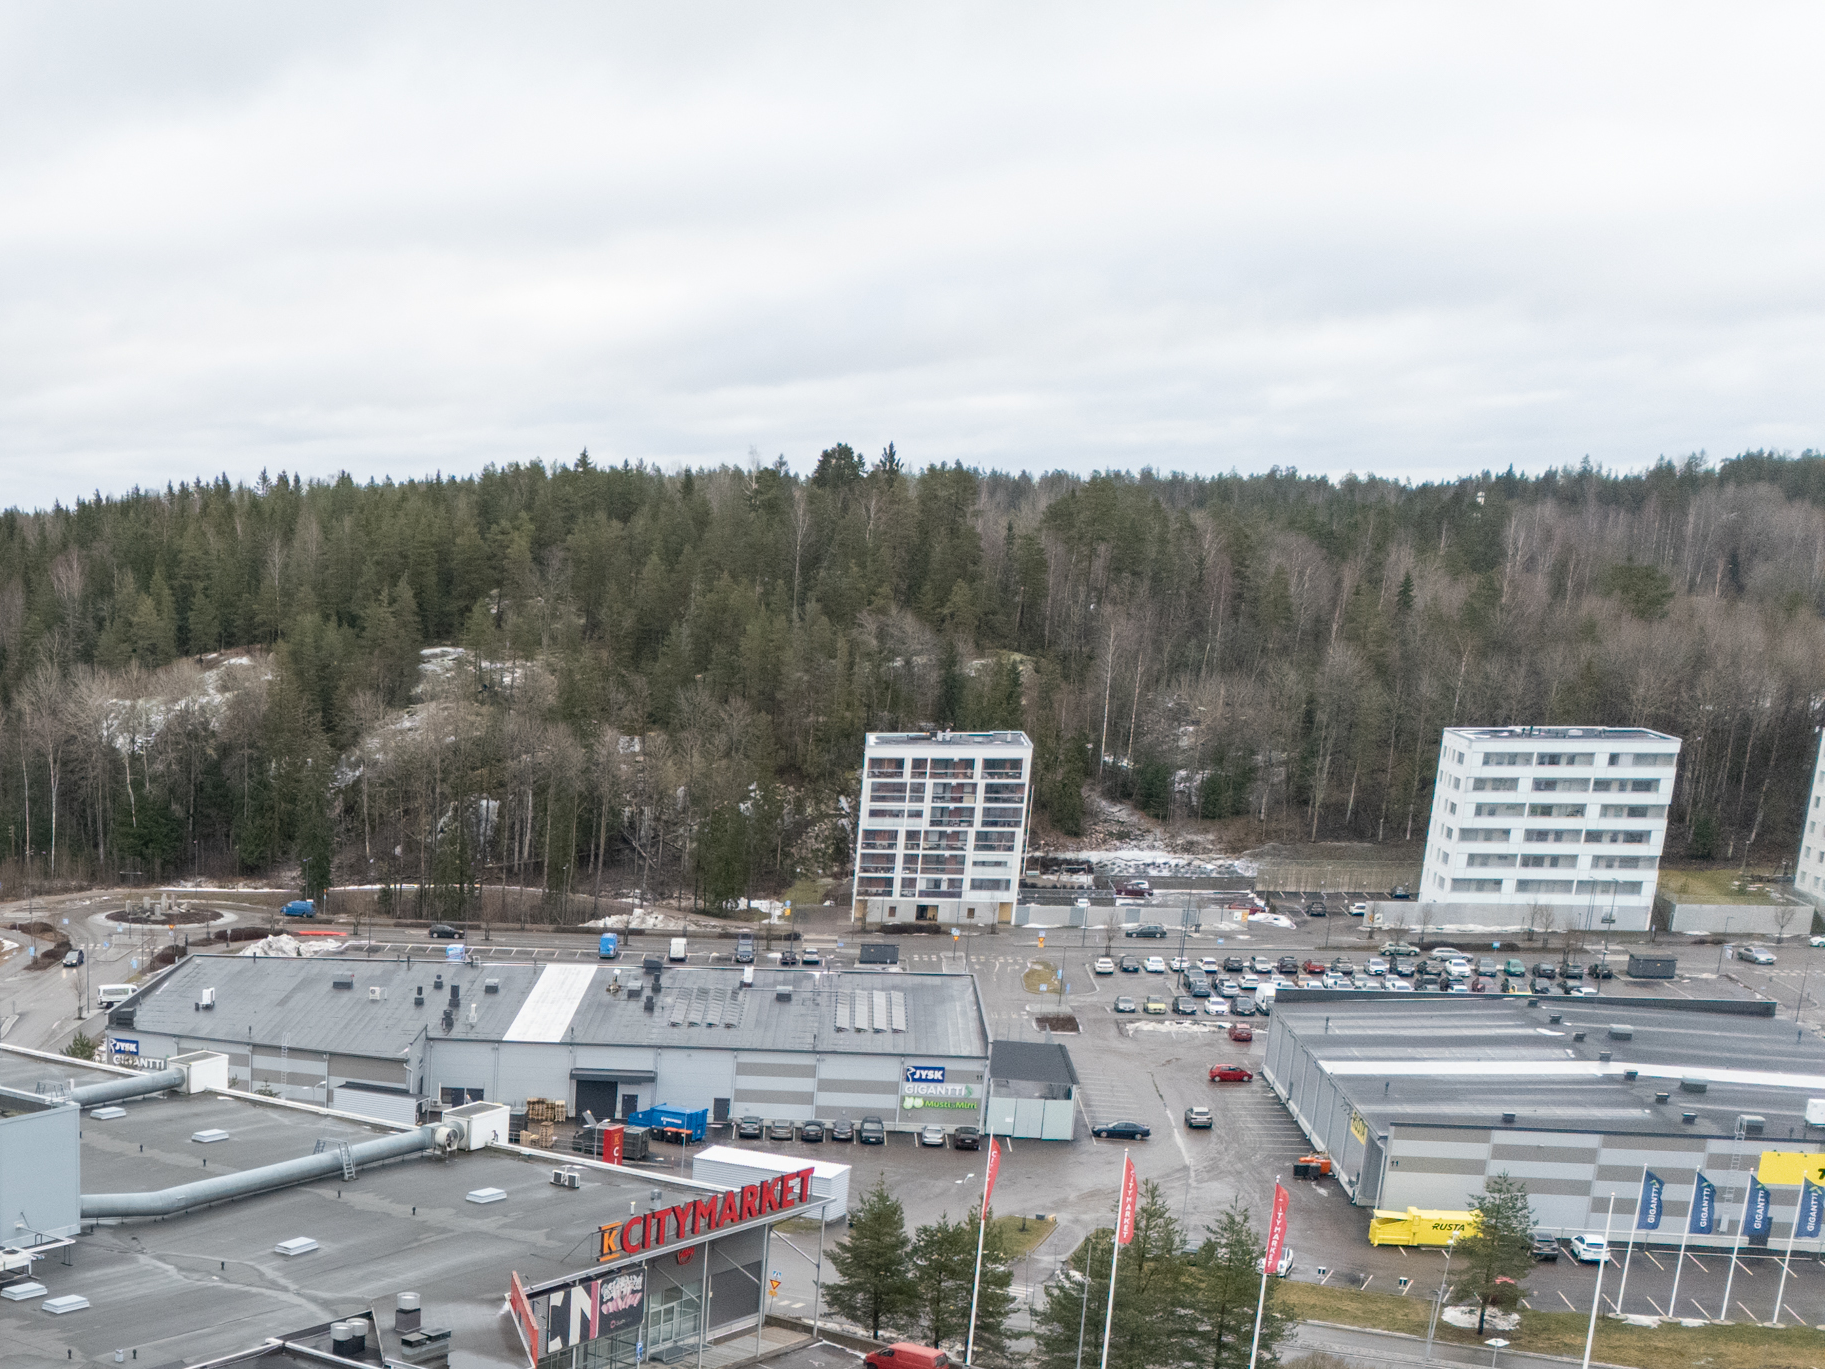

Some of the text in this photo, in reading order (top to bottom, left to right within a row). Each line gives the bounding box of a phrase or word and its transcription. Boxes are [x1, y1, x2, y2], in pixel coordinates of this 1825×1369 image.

[115, 1042, 137, 1052] JYSK
[905, 1084, 965, 1096] GIGANTTI
[914, 1070, 943, 1079] JYSK
[925, 1100, 951, 1108] Musti
[620, 1167, 815, 1254] CITYMARKET
[1123, 1170, 1135, 1239] CITYMARKET
[1647, 1185, 1660, 1223] GIGANTTI
[1700, 1187, 1711, 1228] GIGANTTI
[1753, 1190, 1765, 1230] GIGANTTI
[1806, 1192, 1819, 1231] GIGANTTI
[1432, 1222, 1465, 1231] RUSTA
